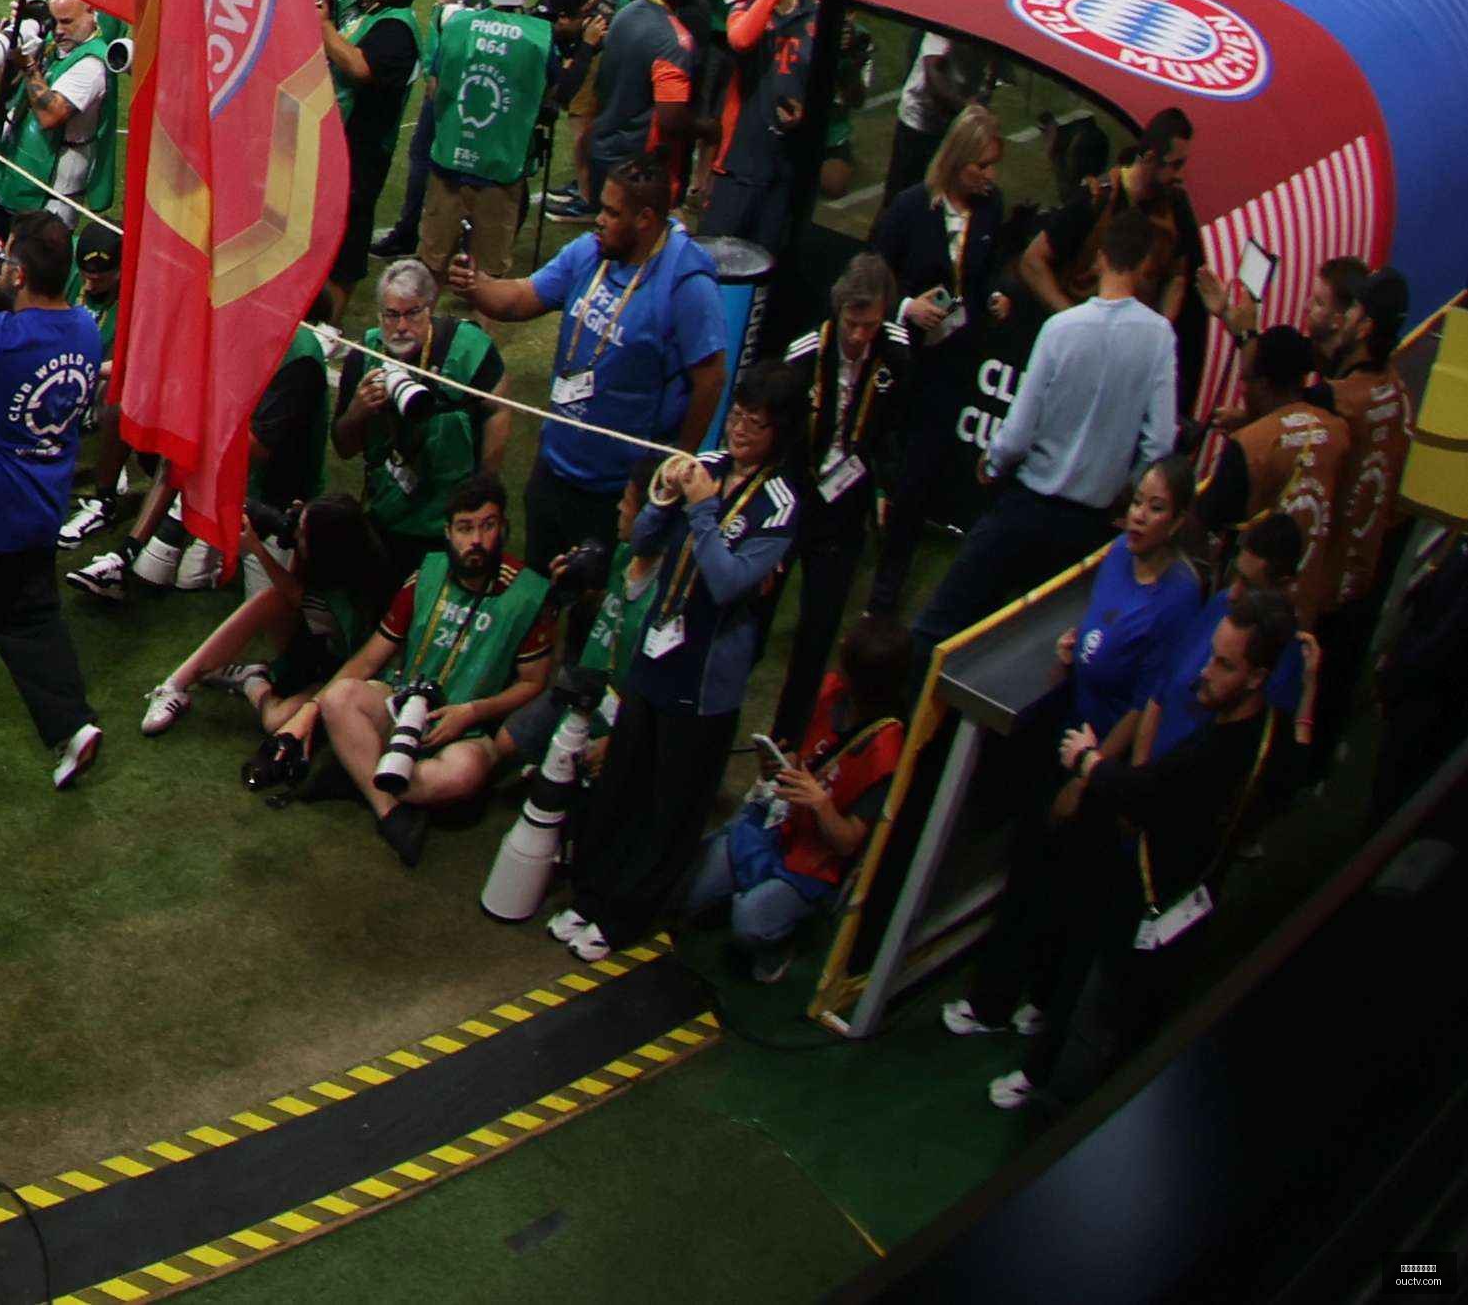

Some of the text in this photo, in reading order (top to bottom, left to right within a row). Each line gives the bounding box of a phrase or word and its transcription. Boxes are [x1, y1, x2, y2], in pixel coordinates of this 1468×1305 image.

[470, 19, 523, 40] PHOTO
[1031, 9, 1085, 35] FC
[8, 382, 33, 422] CLUB
[35, 352, 85, 380] WORLD
